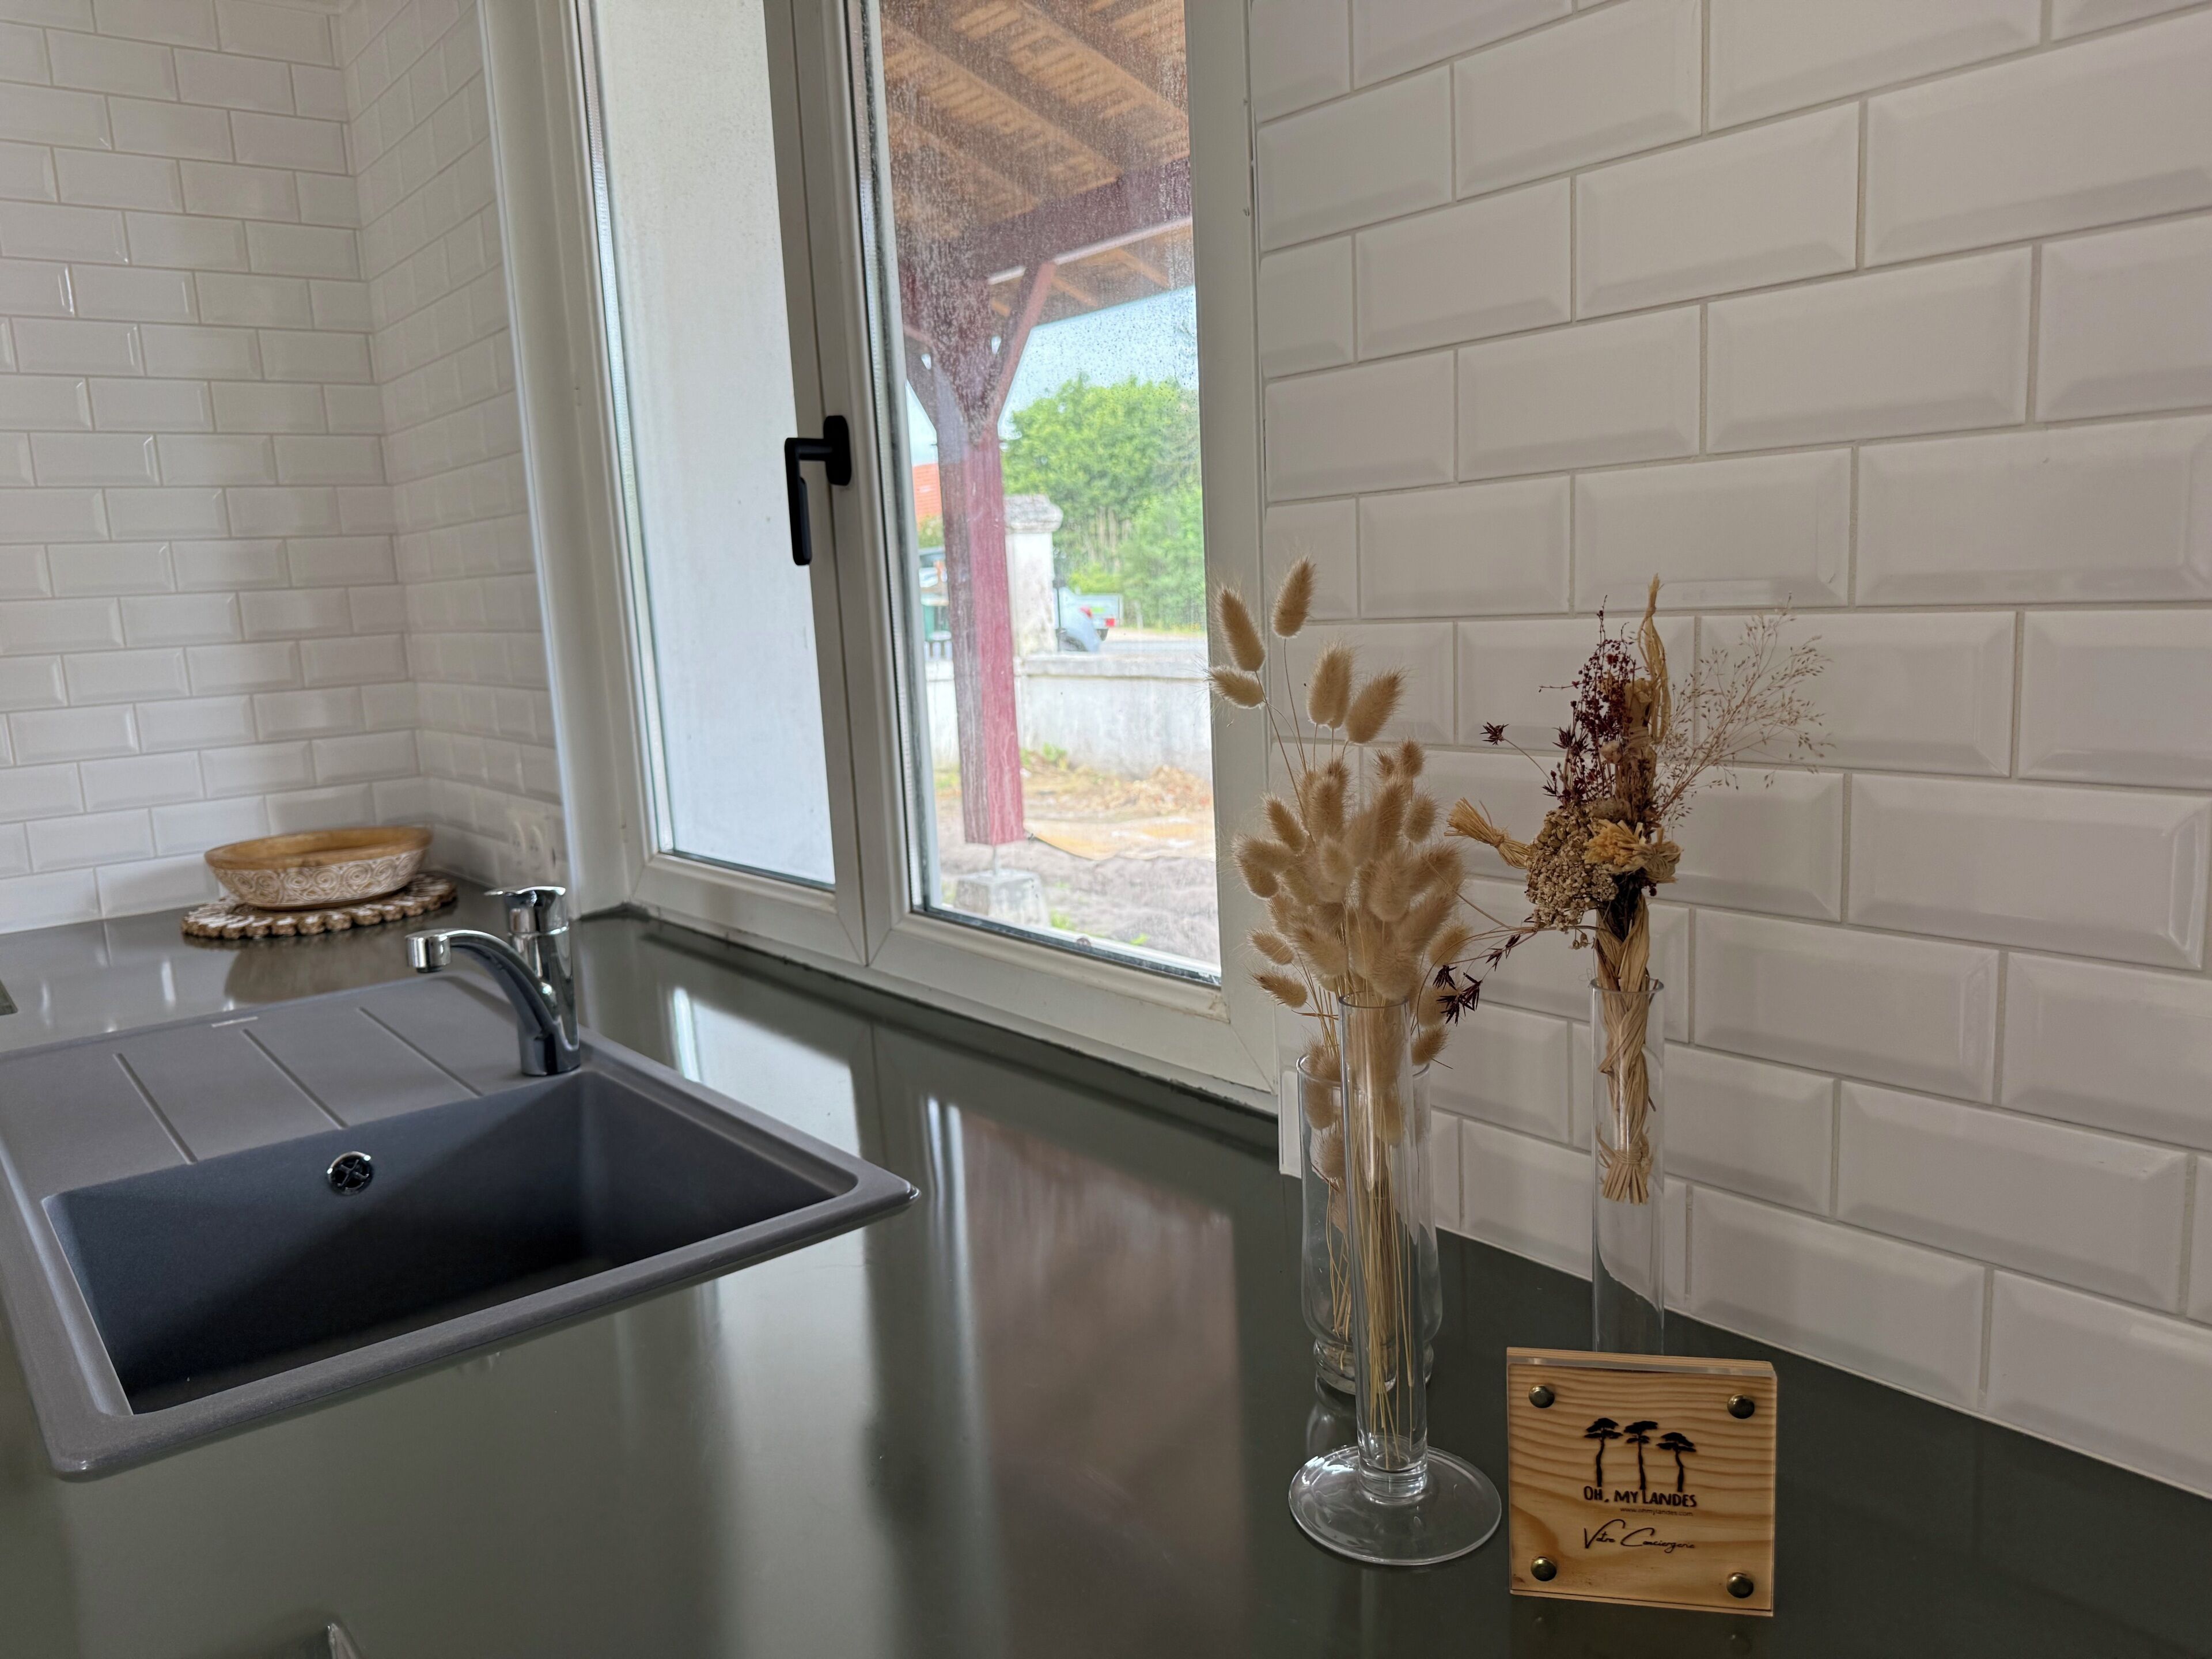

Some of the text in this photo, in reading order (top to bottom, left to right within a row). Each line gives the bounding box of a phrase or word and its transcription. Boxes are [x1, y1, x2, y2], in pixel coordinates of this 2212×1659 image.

[1614, 1490, 1638, 1503] MY
[1642, 1489, 1697, 1508] LANDES
[1620, 1508, 1694, 1516] www.ohmylandes.com
[1584, 1519, 1695, 1554] Votre Conciergerie
